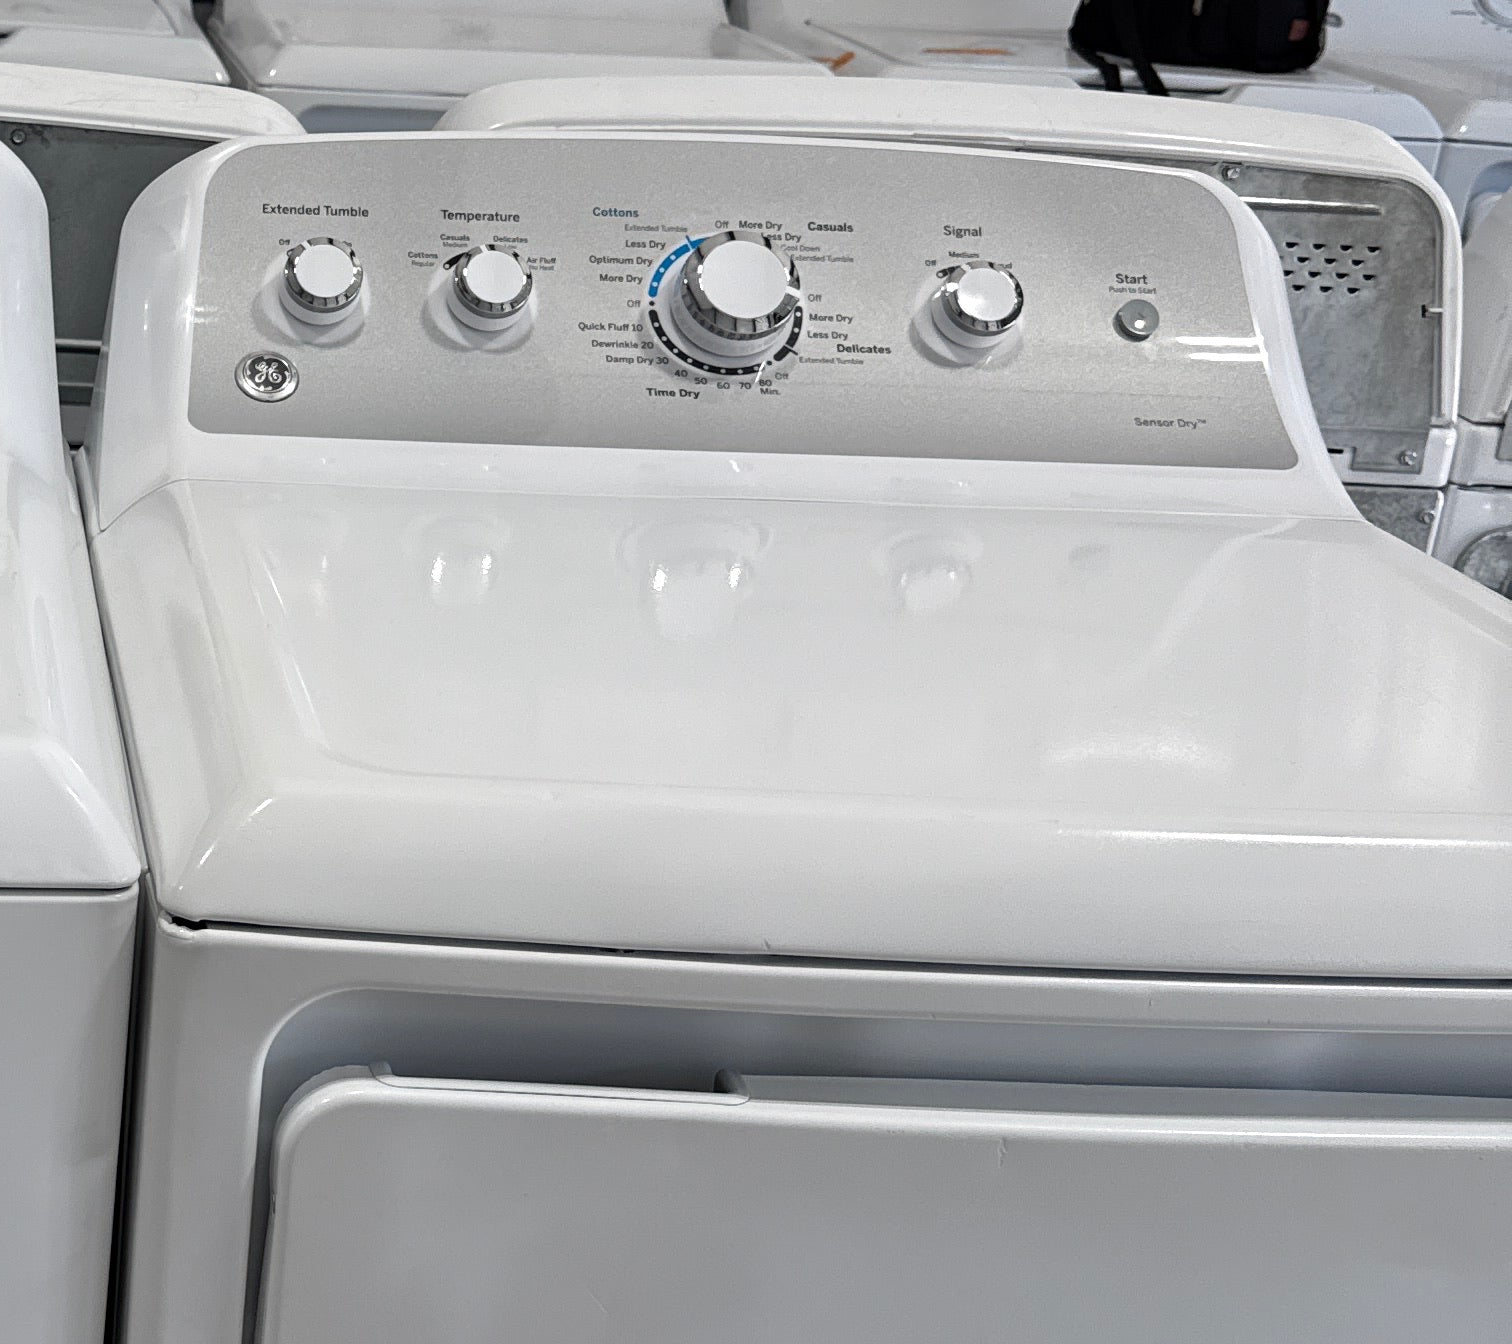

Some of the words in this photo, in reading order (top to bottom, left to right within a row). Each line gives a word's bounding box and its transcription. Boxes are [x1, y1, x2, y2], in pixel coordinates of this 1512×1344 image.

[263, 204, 320, 217] Extended
[324, 206, 369, 218] Tumble
[593, 206, 639, 218] Cottons
[441, 210, 520, 223] Temperature
[739, 221, 763, 229] More
[766, 221, 782, 231] Dry
[808, 222, 854, 232] Casuals
[944, 225, 982, 238] Signal
[626, 240, 646, 249] Less
[649, 240, 665, 250] Dry
[589, 255, 634, 265] Optimum
[637, 256, 652, 267] Dry
[600, 274, 623, 283] More
[627, 275, 642, 284] Dry
[1116, 273, 1148, 285] Start
[808, 294, 822, 302] Off
[809, 314, 833, 322] More
[836, 314, 853, 324] Dry
[578, 322, 606, 331] Quick
[608, 323, 629, 332] Fluff
[632, 324, 642, 332] 10
[808, 331, 828, 339] Less
[832, 331, 848, 340] Dry
[592, 340, 638, 349] Dewrinkle
[641, 341, 654, 349] 20
[837, 344, 892, 354] Delicates
[606, 355, 634, 365] Damp
[637, 356, 653, 365] Dry
[656, 357, 668, 365] 30
[646, 388, 676, 397] Time
[680, 389, 700, 399] Dry
[1134, 417, 1174, 428] Sensor
